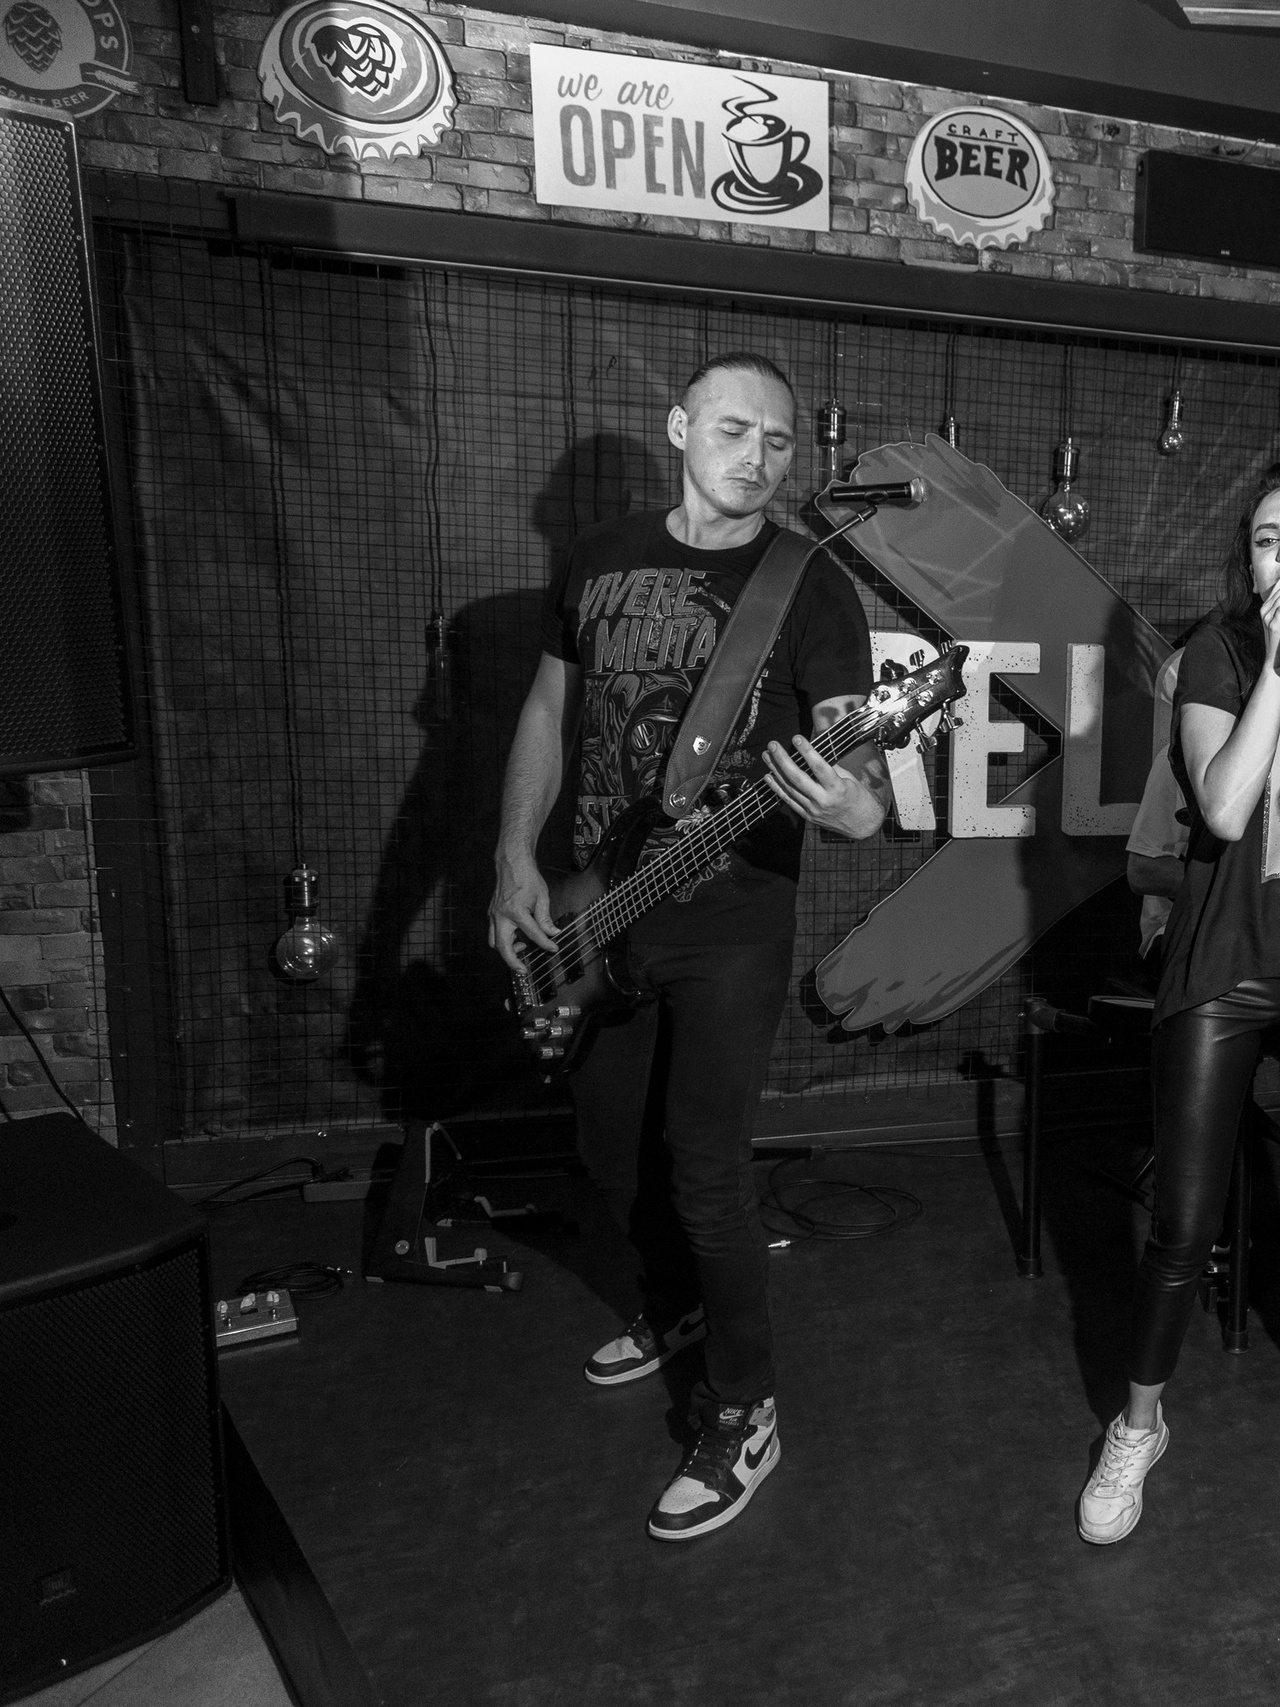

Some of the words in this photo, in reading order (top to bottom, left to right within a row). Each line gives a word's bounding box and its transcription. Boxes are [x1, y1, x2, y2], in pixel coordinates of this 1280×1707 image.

[52, 91, 90, 109] BEER
[557, 73, 602, 101] we
[617, 80, 673, 110] are
[948, 123, 1018, 142] CRAFT
[559, 104, 706, 199] OPEN
[934, 135, 1029, 191] BEER
[595, 616, 719, 673] MILITA
[725, 1407, 744, 1416] NIKE
